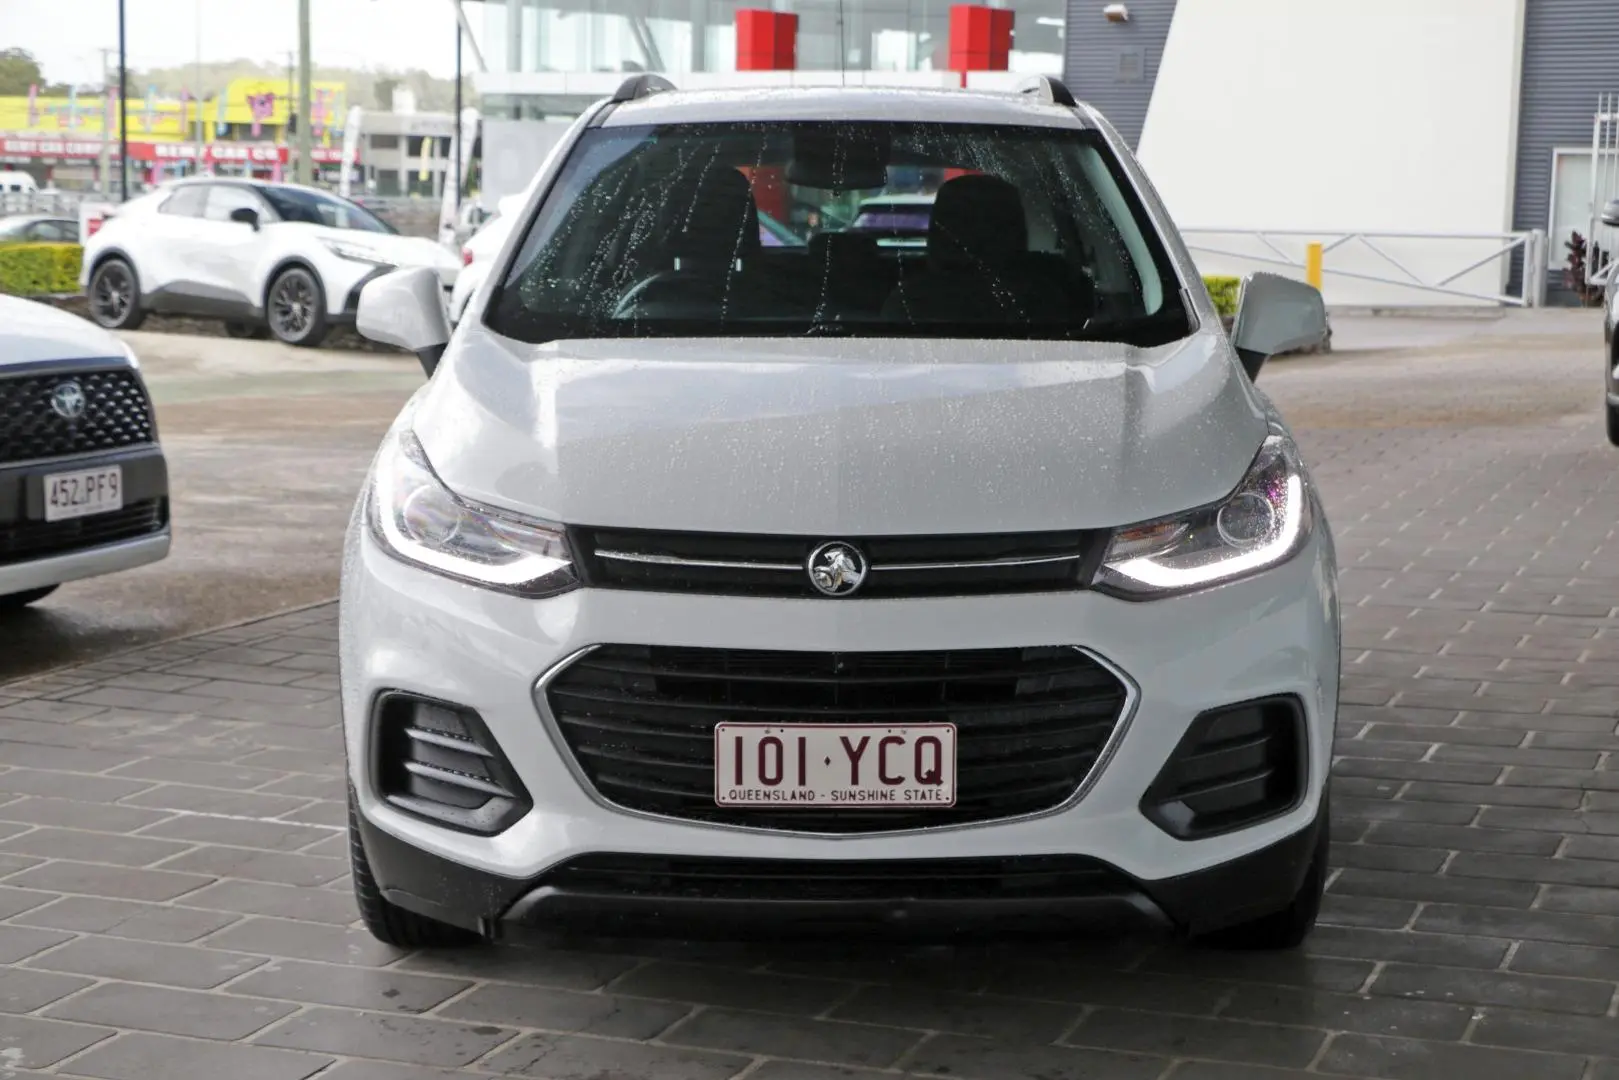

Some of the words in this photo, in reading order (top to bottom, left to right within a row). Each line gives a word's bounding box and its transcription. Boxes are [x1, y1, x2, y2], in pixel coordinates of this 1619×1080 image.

[86, 472, 118, 503] PF9
[734, 736, 806, 786] 101
[839, 735, 944, 786] YCQ
[728, 789, 816, 801] QUEENSLAND
[831, 789, 896, 801] SUNSHINE
[904, 789, 942, 801] STATE
